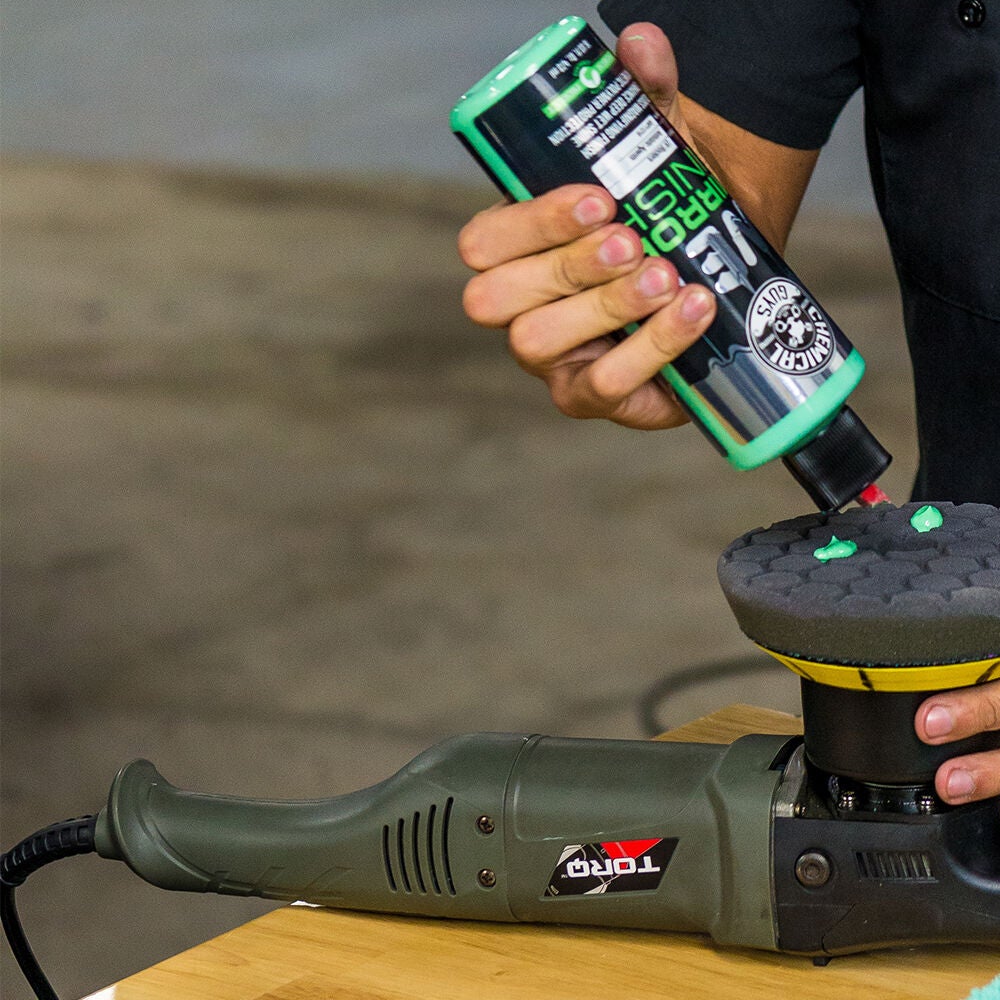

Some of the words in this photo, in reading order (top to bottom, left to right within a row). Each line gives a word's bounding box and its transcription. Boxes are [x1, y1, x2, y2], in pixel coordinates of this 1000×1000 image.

[624, 146, 707, 231] INISH
[641, 175, 728, 256] IRRO
[756, 285, 788, 317] GUYS
[769, 305, 831, 371] CHEMICAL
[566, 855, 661, 878] TORQ
